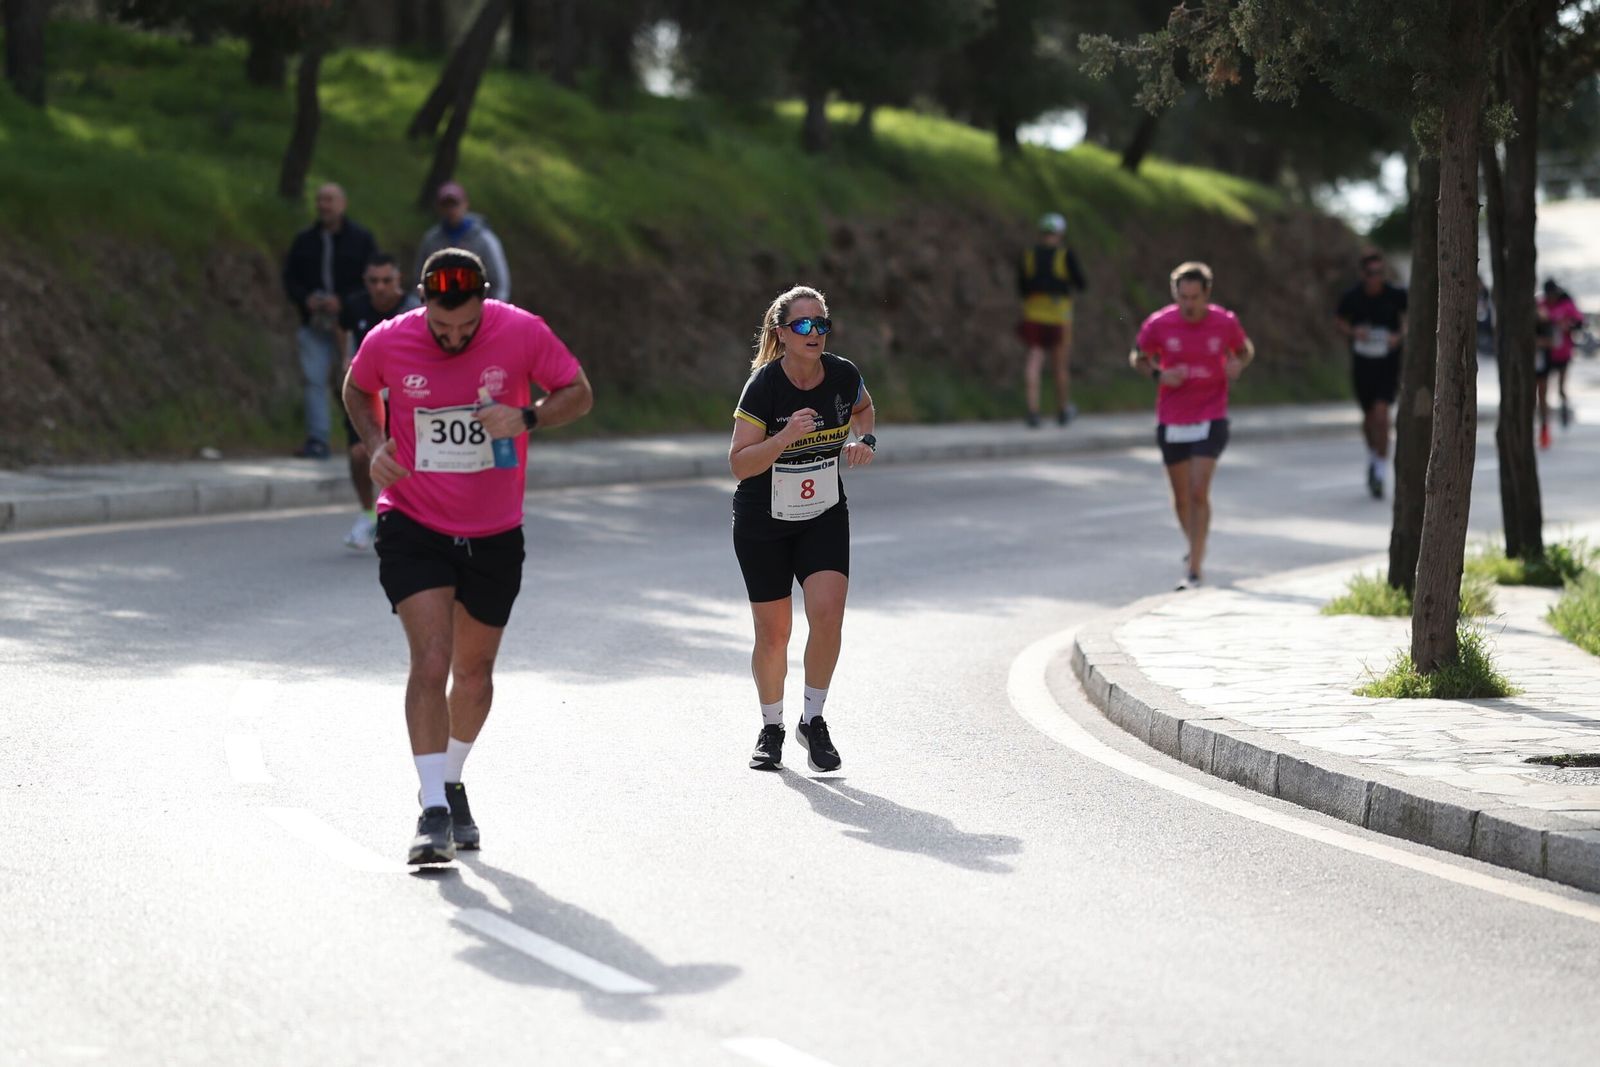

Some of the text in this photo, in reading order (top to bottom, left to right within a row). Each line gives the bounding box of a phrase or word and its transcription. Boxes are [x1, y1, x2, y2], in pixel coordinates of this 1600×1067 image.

[430, 419, 486, 445] 308
[829, 429, 849, 441] MÁLA
[800, 478, 815, 500] 8
